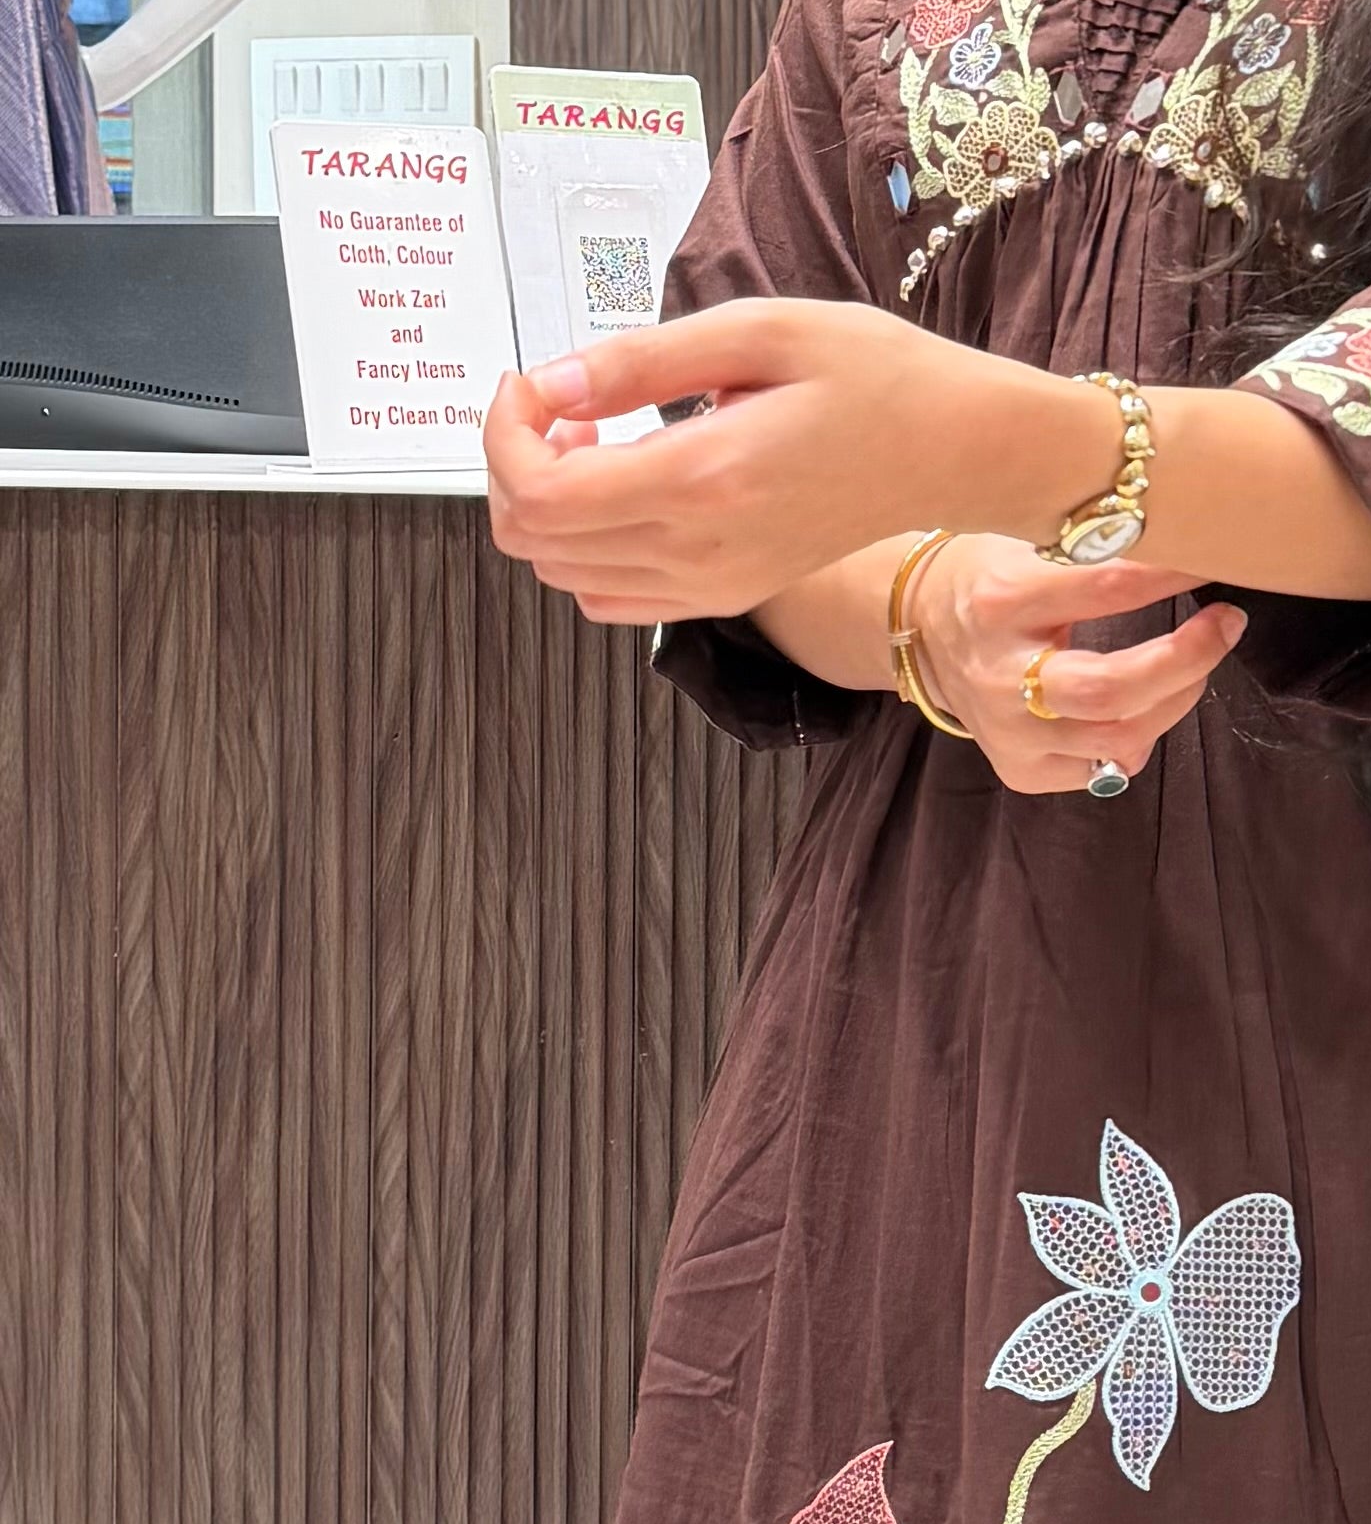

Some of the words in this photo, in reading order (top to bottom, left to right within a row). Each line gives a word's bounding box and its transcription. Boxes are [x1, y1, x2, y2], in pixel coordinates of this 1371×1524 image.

[516, 101, 685, 135] TARANGG
[301, 148, 467, 184] TARANGG
[319, 210, 344, 230] No
[350, 211, 443, 232] Guarantee
[448, 214, 465, 233] of
[339, 244, 391, 266] Cloth,
[397, 245, 454, 265] Colour
[358, 289, 407, 308] Work
[411, 289, 446, 309] Zari
[390, 325, 423, 344] and
[357, 360, 410, 383] Fancy
[416, 360, 466, 378] Items
[350, 406, 381, 429] Dry
[388, 405, 438, 425] Clean
[444, 405, 483, 428] Only
